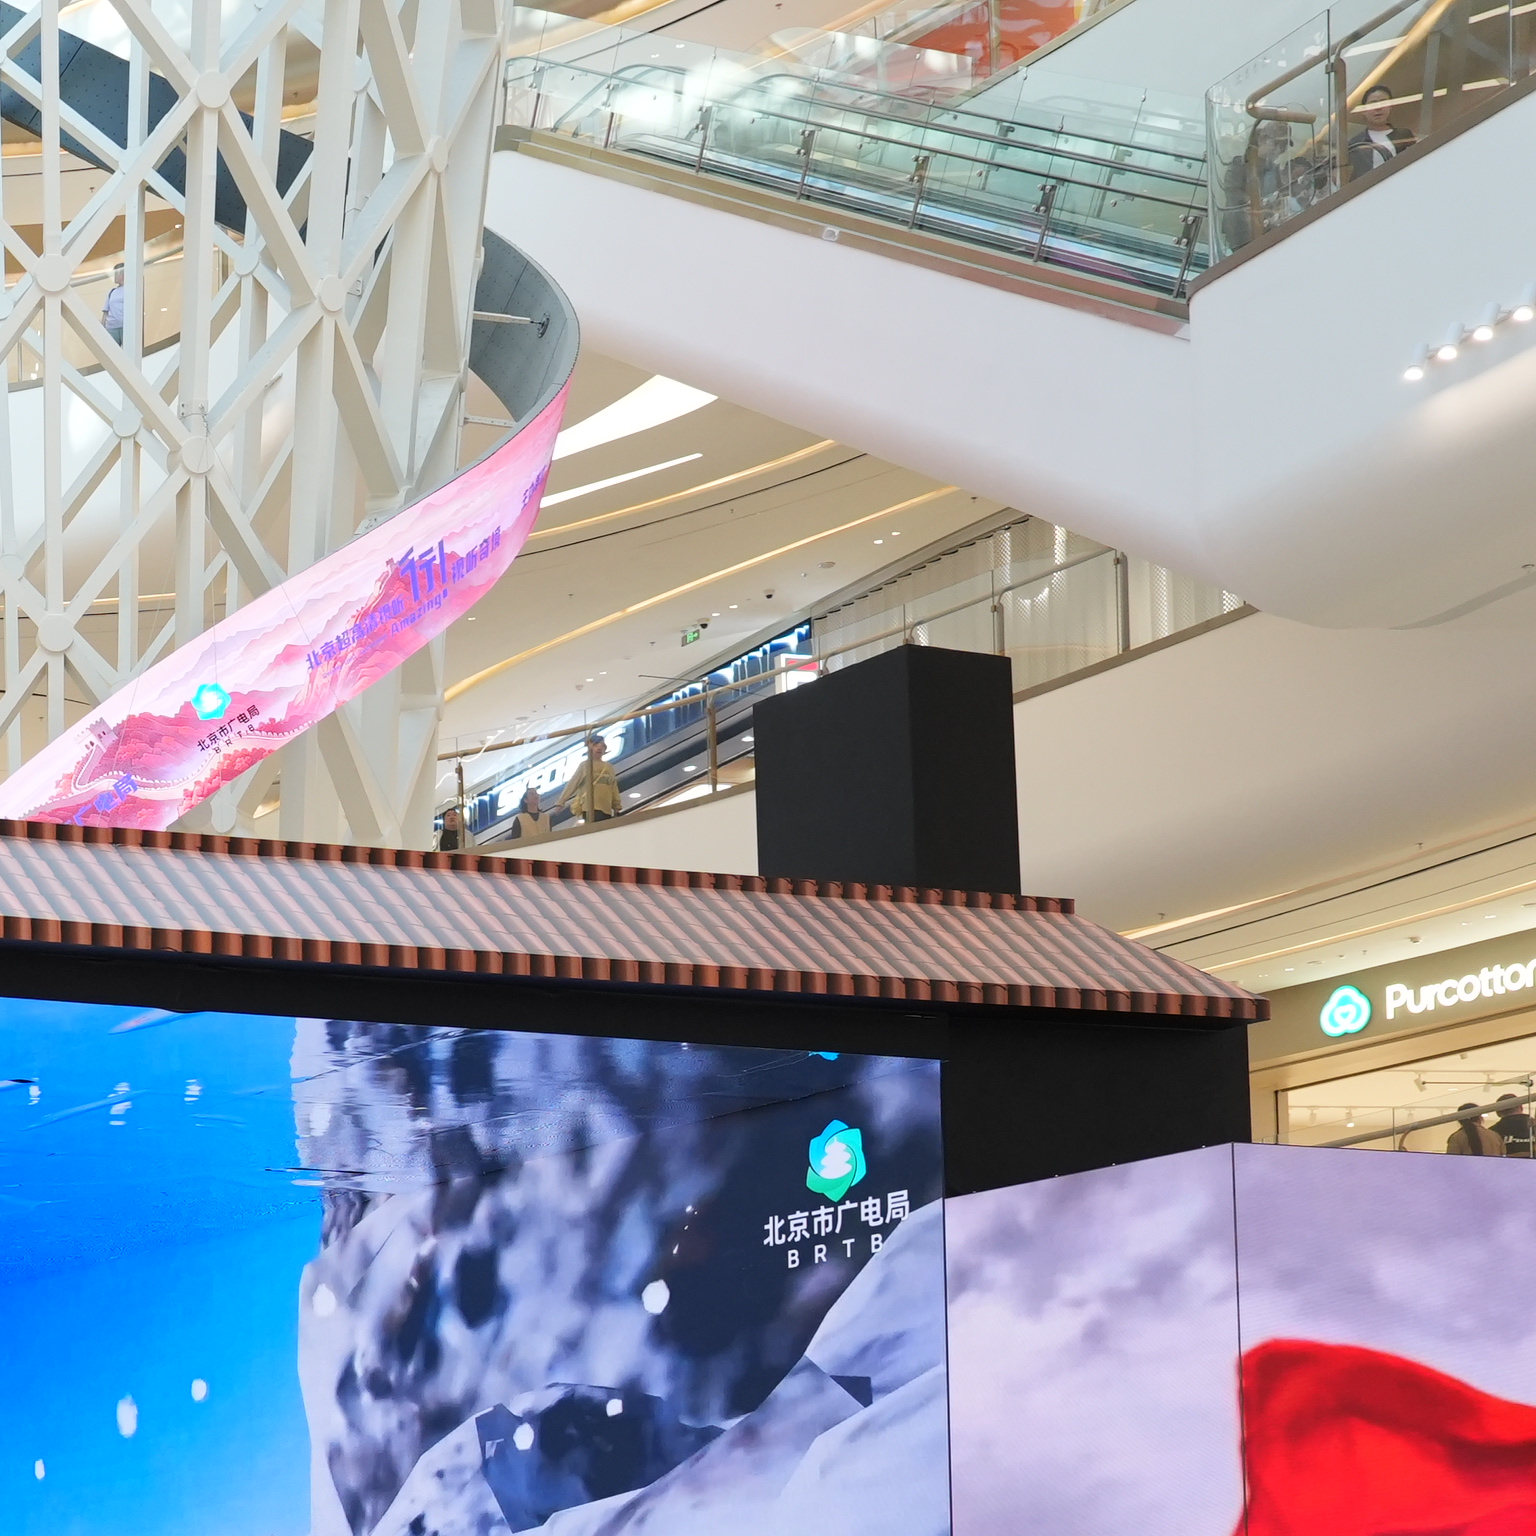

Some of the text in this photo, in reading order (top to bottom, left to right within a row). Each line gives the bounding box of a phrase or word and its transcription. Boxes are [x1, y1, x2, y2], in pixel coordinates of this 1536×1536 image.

[197, 704, 261, 753] 北京市广电局
[763, 1189, 911, 1247] 北京市广电局
[787, 1233, 884, 1269] BRTB
